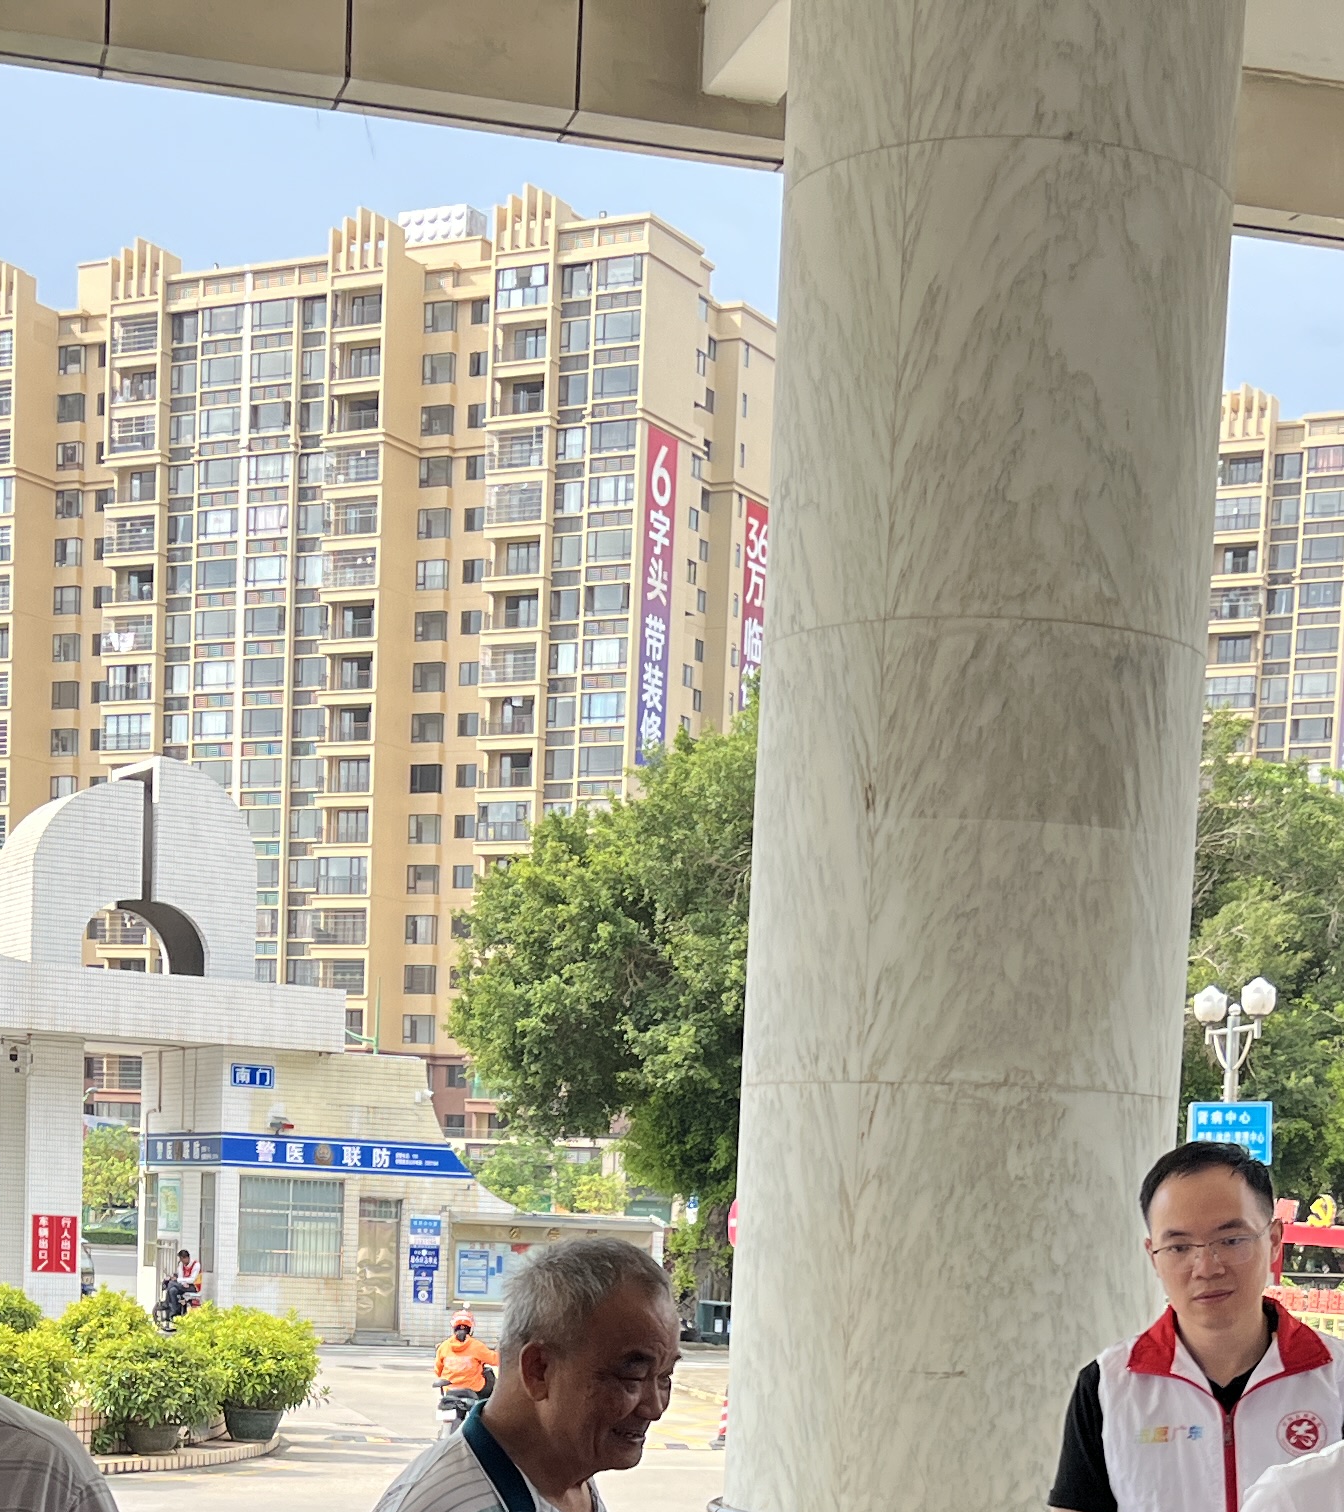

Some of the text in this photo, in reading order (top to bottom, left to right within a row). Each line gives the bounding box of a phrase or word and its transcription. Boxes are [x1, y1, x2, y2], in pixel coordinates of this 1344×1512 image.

[639, 445, 672, 751] 6字头 带装修
[234, 1067, 271, 1086] 南门
[60, 1216, 72, 1261] 行人出口
